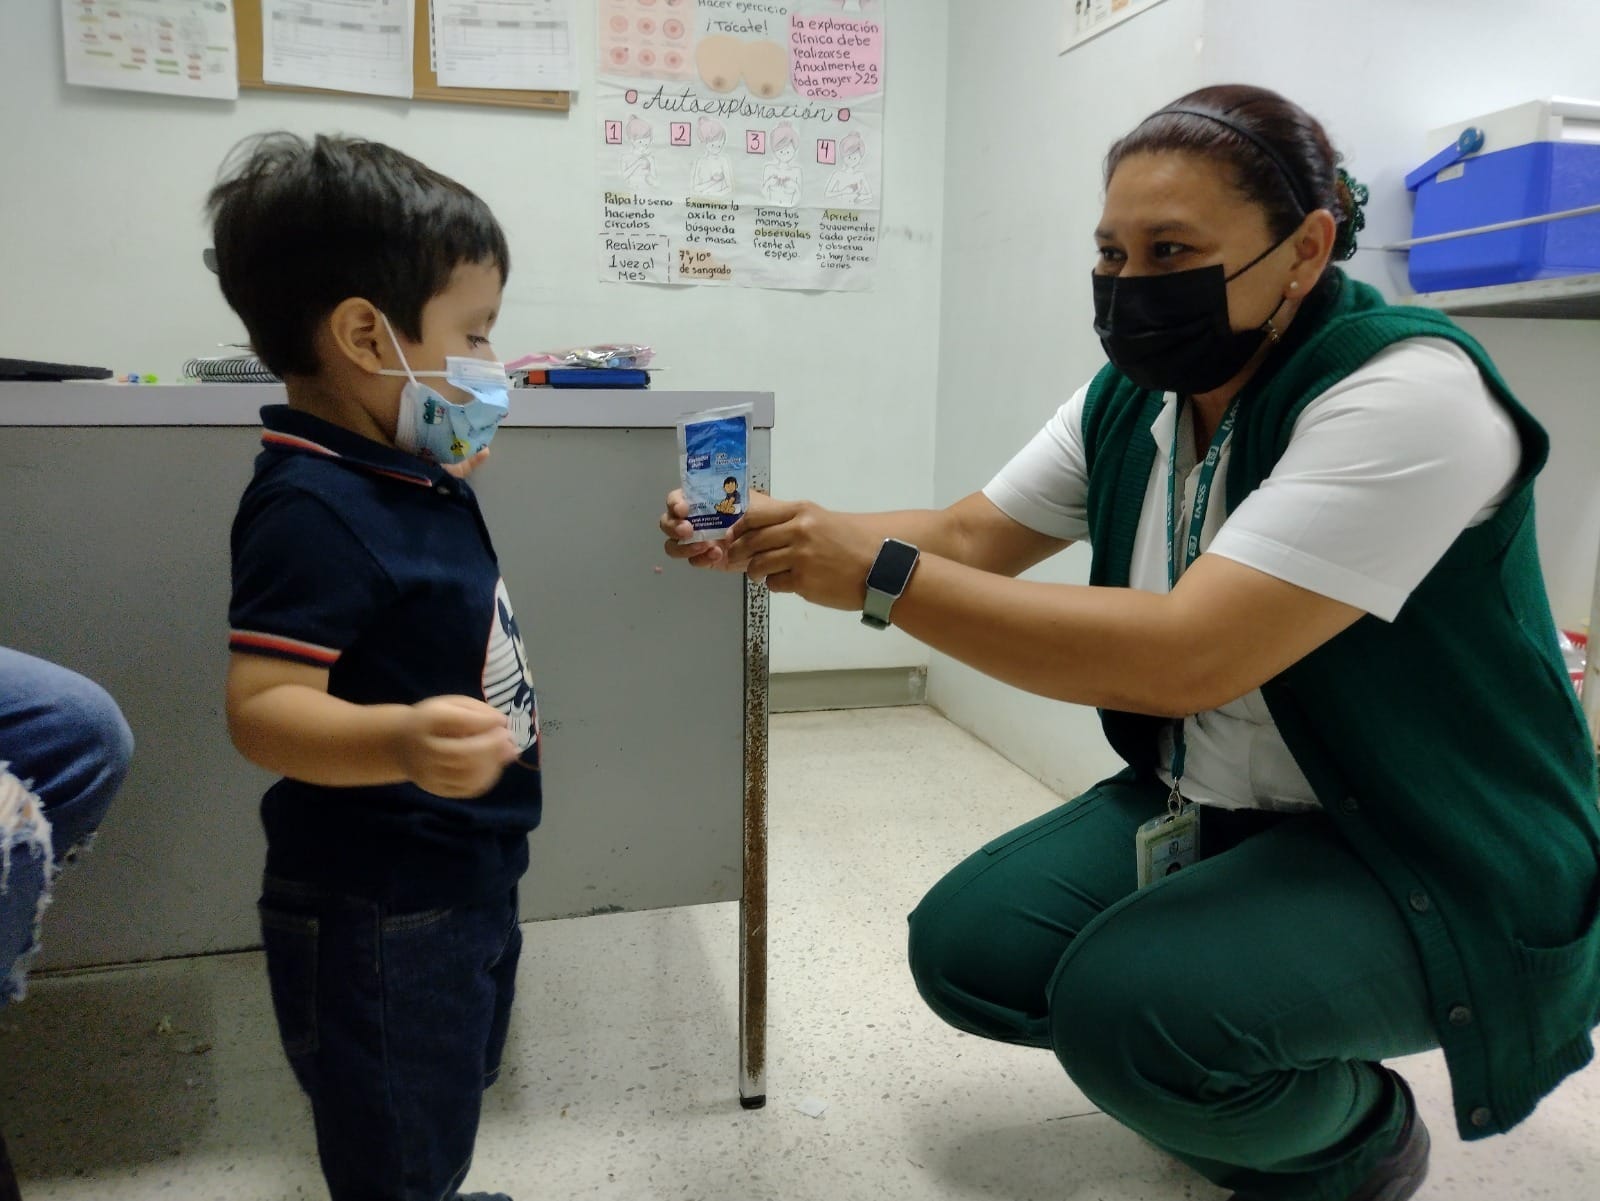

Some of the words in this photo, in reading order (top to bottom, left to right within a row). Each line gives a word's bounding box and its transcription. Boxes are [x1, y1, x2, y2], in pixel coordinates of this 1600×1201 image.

[736, 2, 787, 15] ejercicio
[792, 16, 804, 28] La
[808, 18, 879, 33] exploración
[837, 34, 871, 46] debe
[793, 46, 850, 59] realizarse
[795, 60, 865, 72] Anualmente
[869, 63, 877, 72] a
[794, 73, 818, 86] toda
[822, 76, 852, 87] mujer
[609, 123, 619, 141] 1
[674, 125, 685, 142] 2
[750, 133, 760, 150] 3
[604, 192, 631, 206] Palpa
[633, 194, 646, 205] tu
[647, 198, 673, 206] seno
[686, 197, 728, 210] Examina
[731, 200, 739, 211] la
[604, 206, 655, 219] haciendo
[687, 211, 716, 219] axila
[753, 207, 781, 217] Toma
[783, 209, 799, 218] tus
[821, 209, 858, 222] Aprieta
[755, 218, 792, 228] mamas
[686, 233, 700, 243] de
[754, 227, 811, 239] observalas
[606, 238, 660, 250] Realizar
[753, 237, 782, 249] frente
[784, 240, 795, 249] al
[825, 242, 863, 251] observa
[608, 254, 617, 268] 1
[619, 260, 640, 268] vez
[642, 257, 654, 270] al
[679, 263, 689, 273] de
[692, 264, 732, 278] sangrado
[1194, 484, 1207, 519] IMSS
